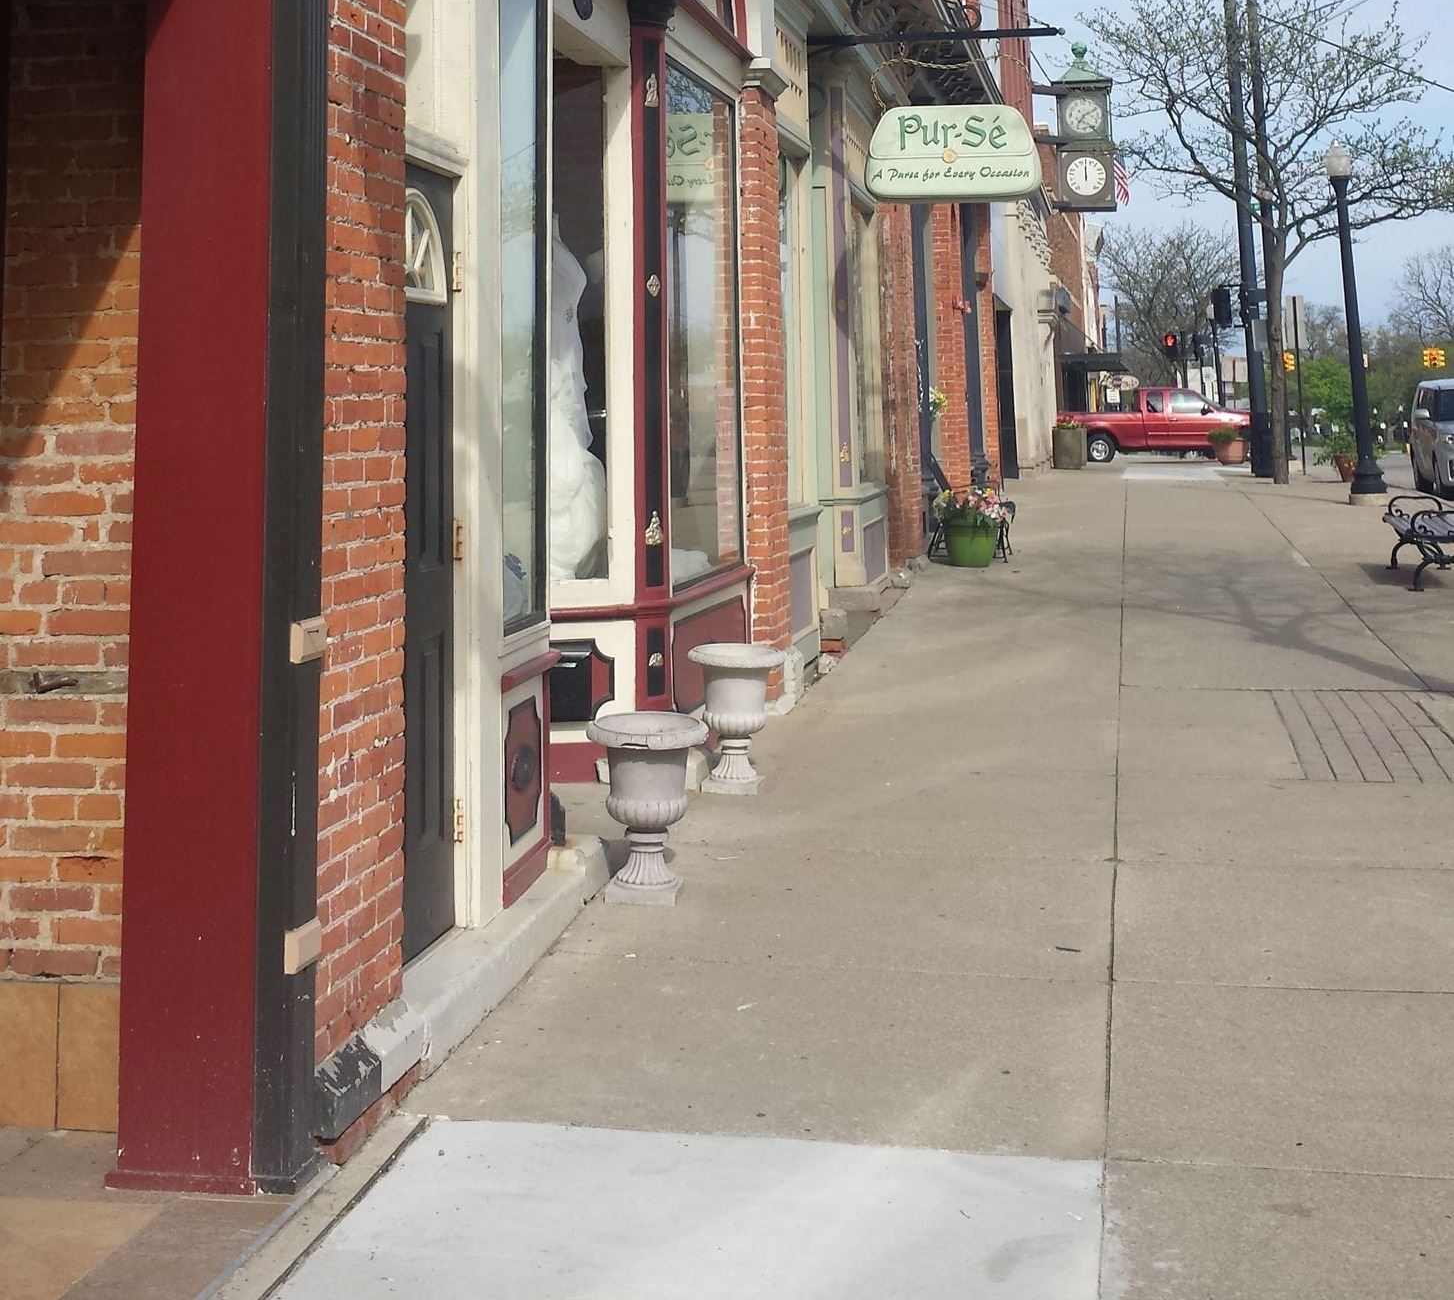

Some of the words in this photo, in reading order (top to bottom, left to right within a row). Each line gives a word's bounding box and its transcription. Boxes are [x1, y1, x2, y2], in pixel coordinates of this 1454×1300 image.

[871, 168, 883, 182] A
[887, 168, 919, 181] Purse
[922, 169, 941, 182] for
[943, 166, 976, 181] Every
[979, 166, 1030, 179] Occasion
